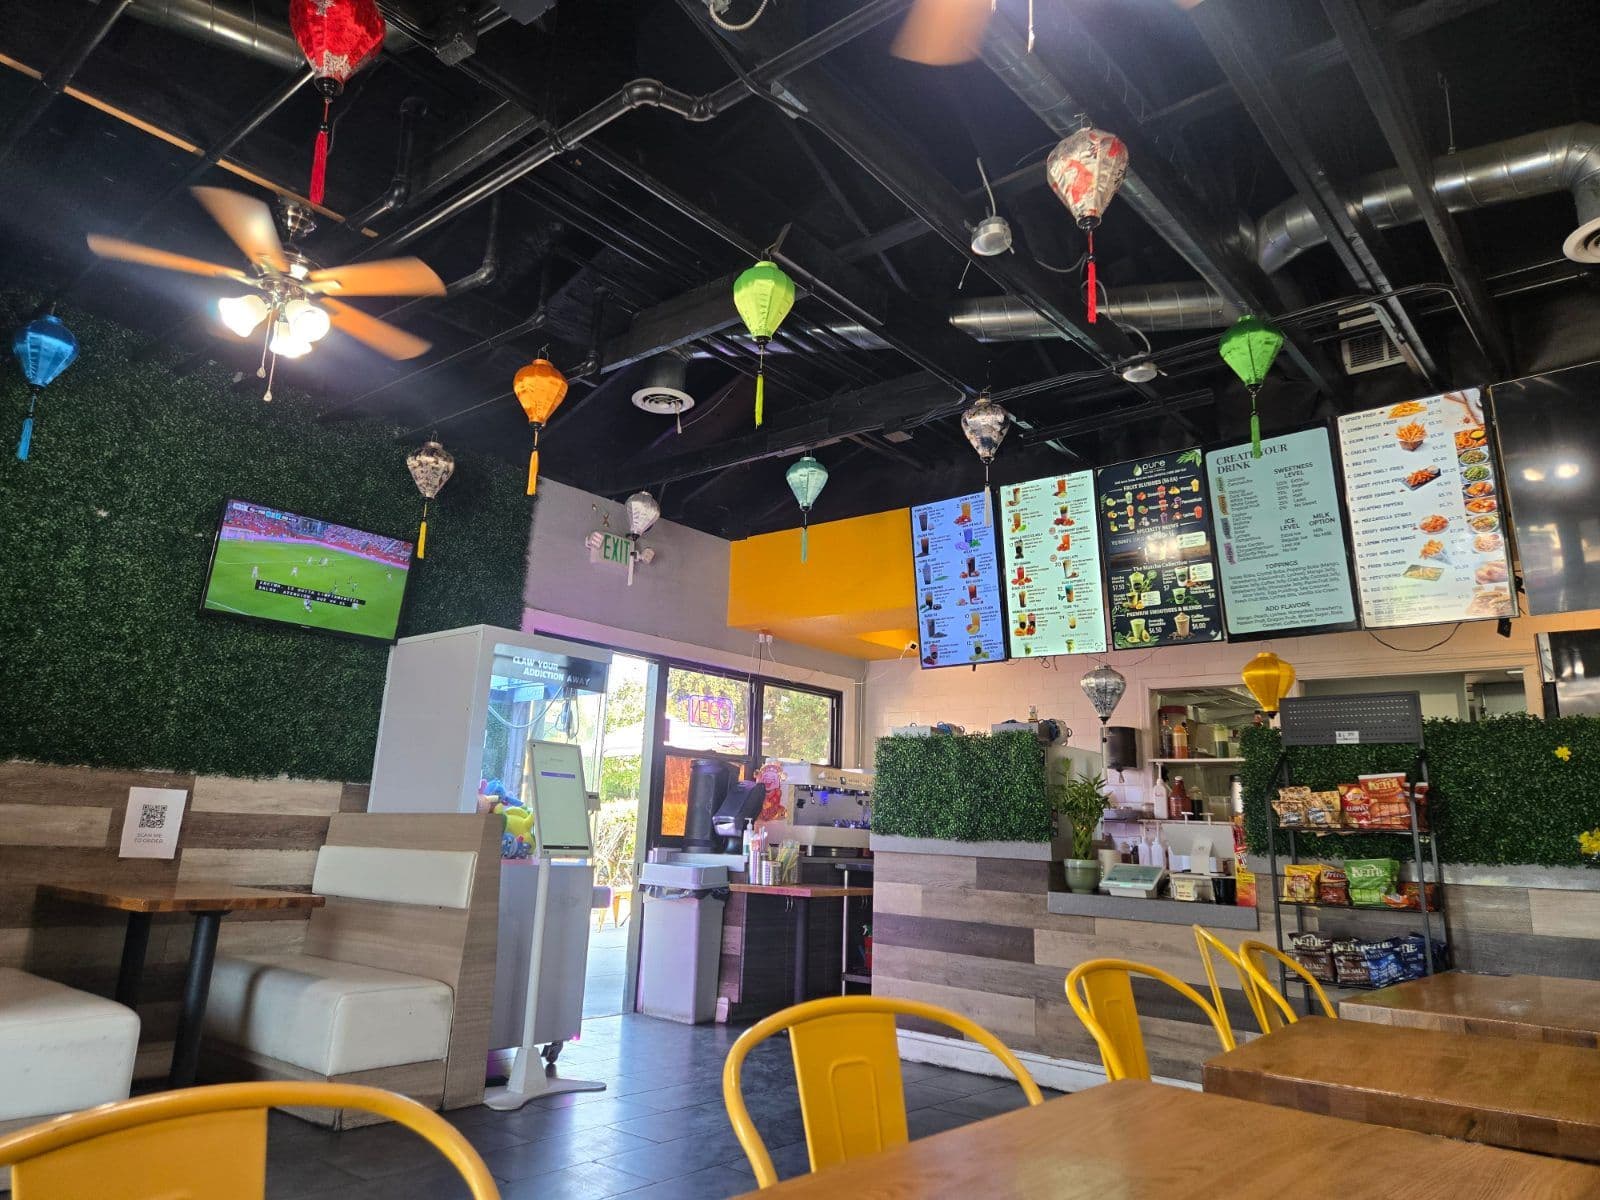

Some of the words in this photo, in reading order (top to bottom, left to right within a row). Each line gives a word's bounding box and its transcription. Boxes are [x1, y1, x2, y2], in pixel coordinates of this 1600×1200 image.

[1262, 444, 1287, 456] OUR
[1142, 459, 1165, 470] pure
[1217, 461, 1250, 474] DRINK
[1274, 462, 1312, 474] SWEETNESS
[1309, 518, 1335, 526] OPTION
[603, 534, 630, 566] EXIT
[1265, 560, 1298, 569] TOPPINGS
[512, 655, 535, 667] CLAW
[538, 659, 559, 671] YOUR
[523, 667, 564, 681] ADDICTION
[566, 674, 590, 686] AWAY
